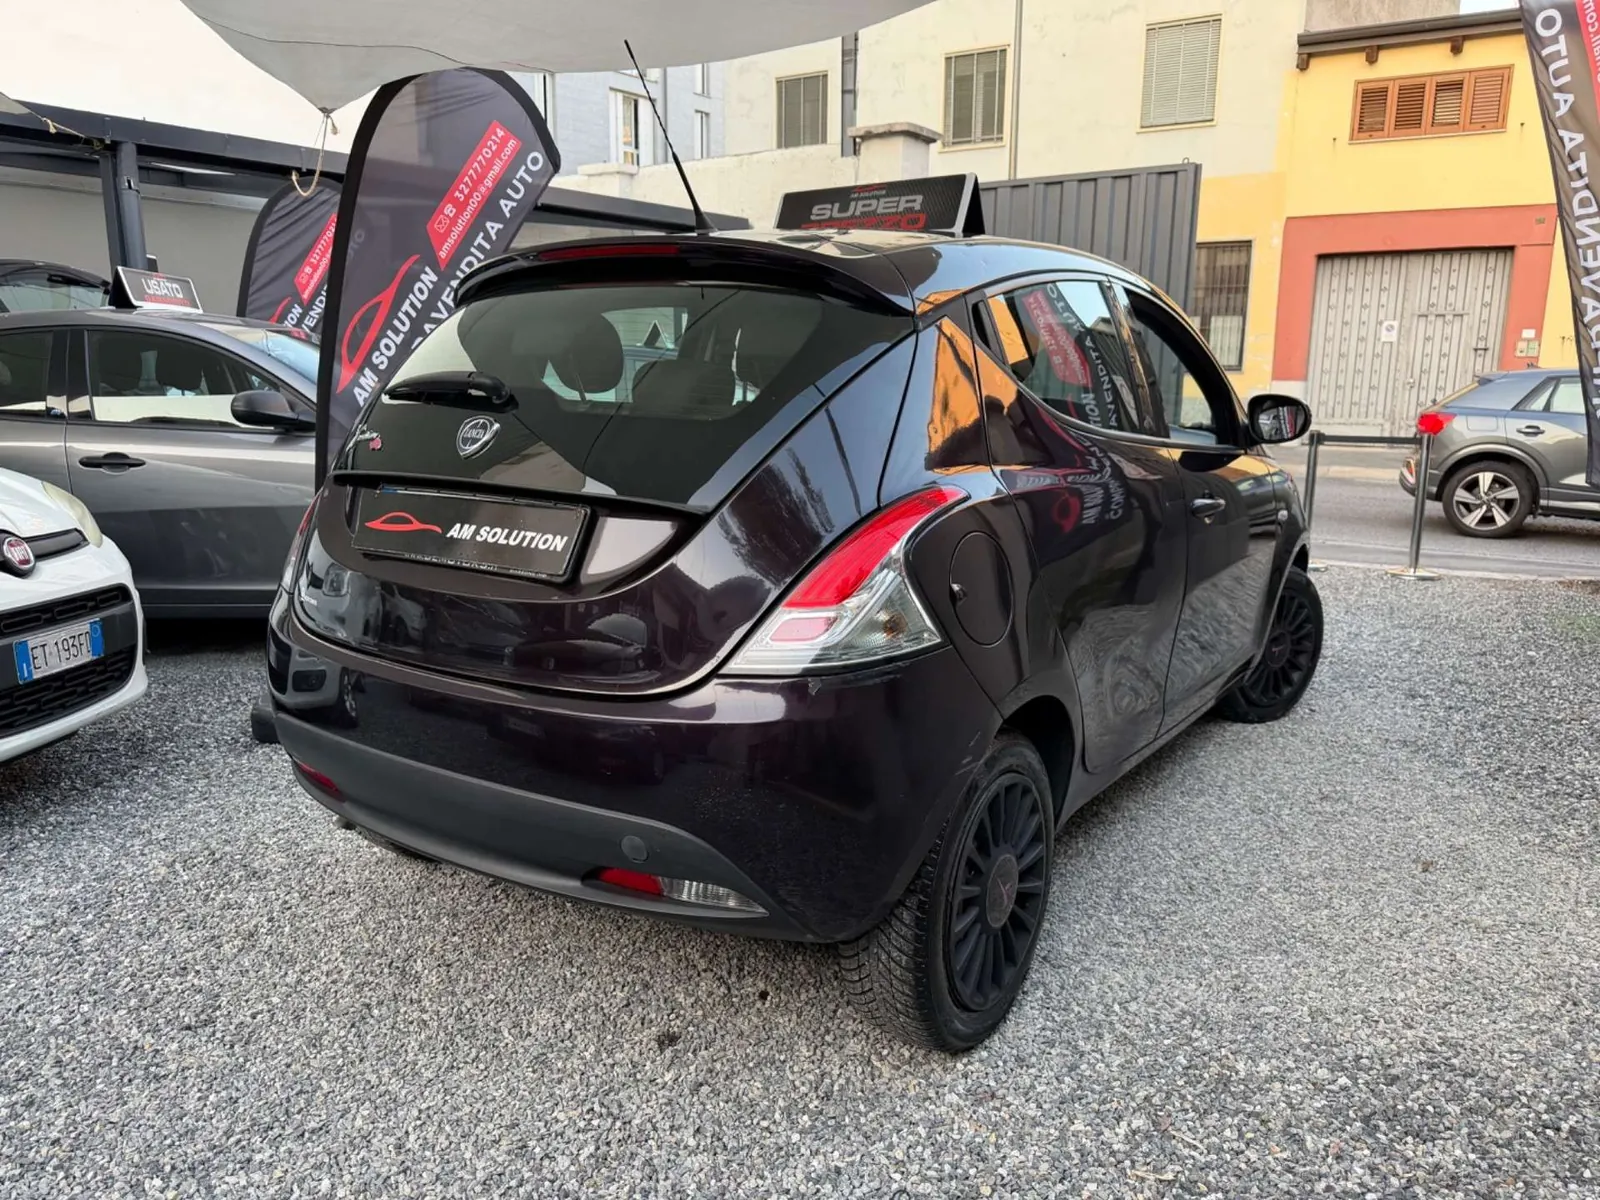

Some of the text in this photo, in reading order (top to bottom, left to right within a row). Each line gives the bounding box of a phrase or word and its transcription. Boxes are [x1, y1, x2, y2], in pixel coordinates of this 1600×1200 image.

[454, 127, 505, 202] 3277770214
[499, 151, 544, 219] AUTO
[438, 139, 517, 259] amsolution00@gmail.com
[809, 194, 924, 220] SUPER
[141, 277, 184, 299] USATO
[353, 265, 439, 407] AM SOLUTION
[446, 523, 569, 552] AM SOLUTION
[31, 643, 48, 670] ET
